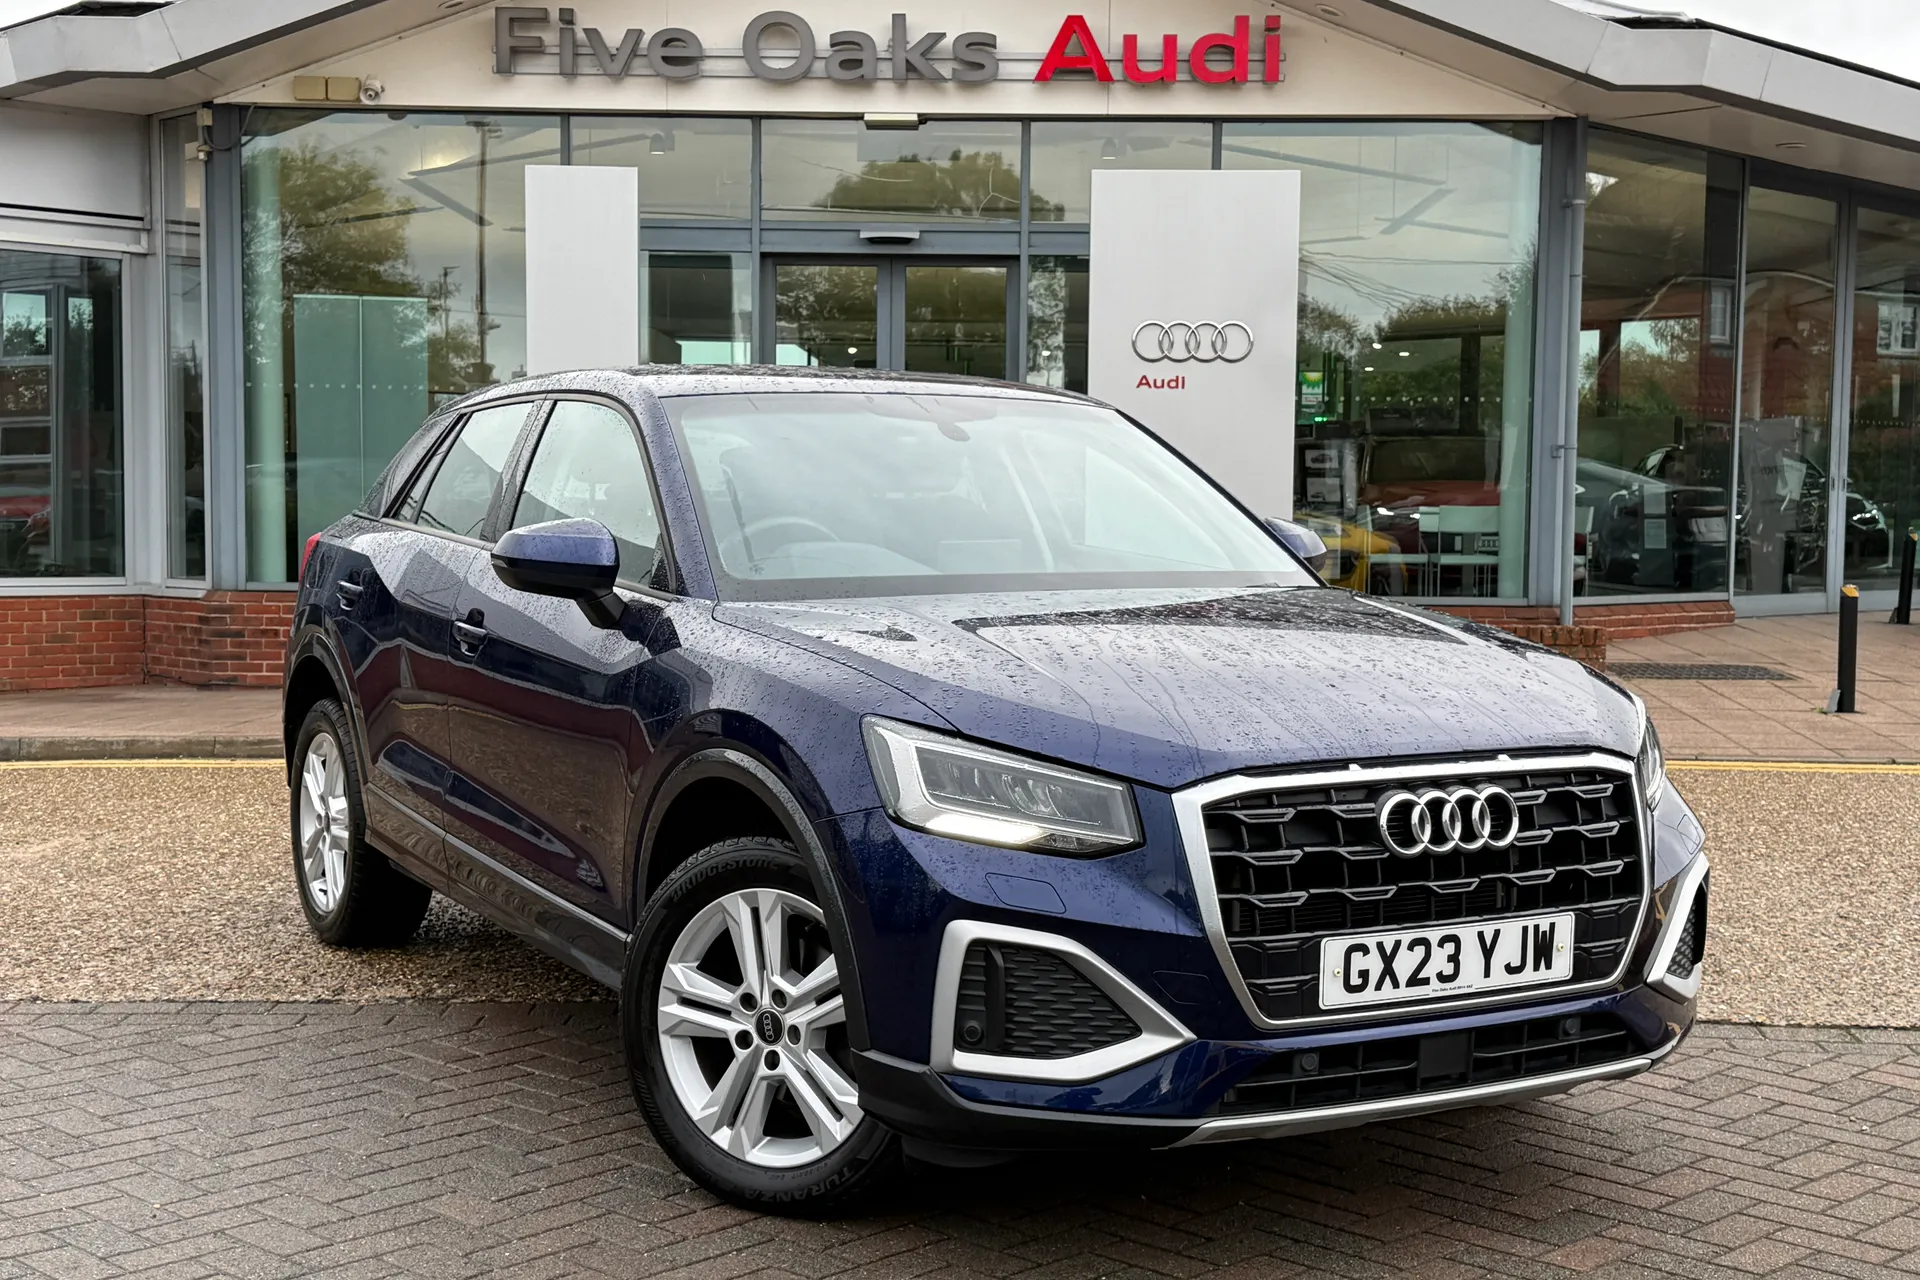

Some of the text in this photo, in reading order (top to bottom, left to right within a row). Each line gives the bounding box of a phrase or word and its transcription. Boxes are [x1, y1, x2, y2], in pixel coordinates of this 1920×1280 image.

[495, 7, 1281, 84] Five Oaks Audi
[1136, 374, 1186, 390] Audi
[670, 855, 780, 902] BRIDGESTONE
[1343, 922, 1556, 995] GX23 YJW
[743, 1166, 855, 1203] TURANZA
